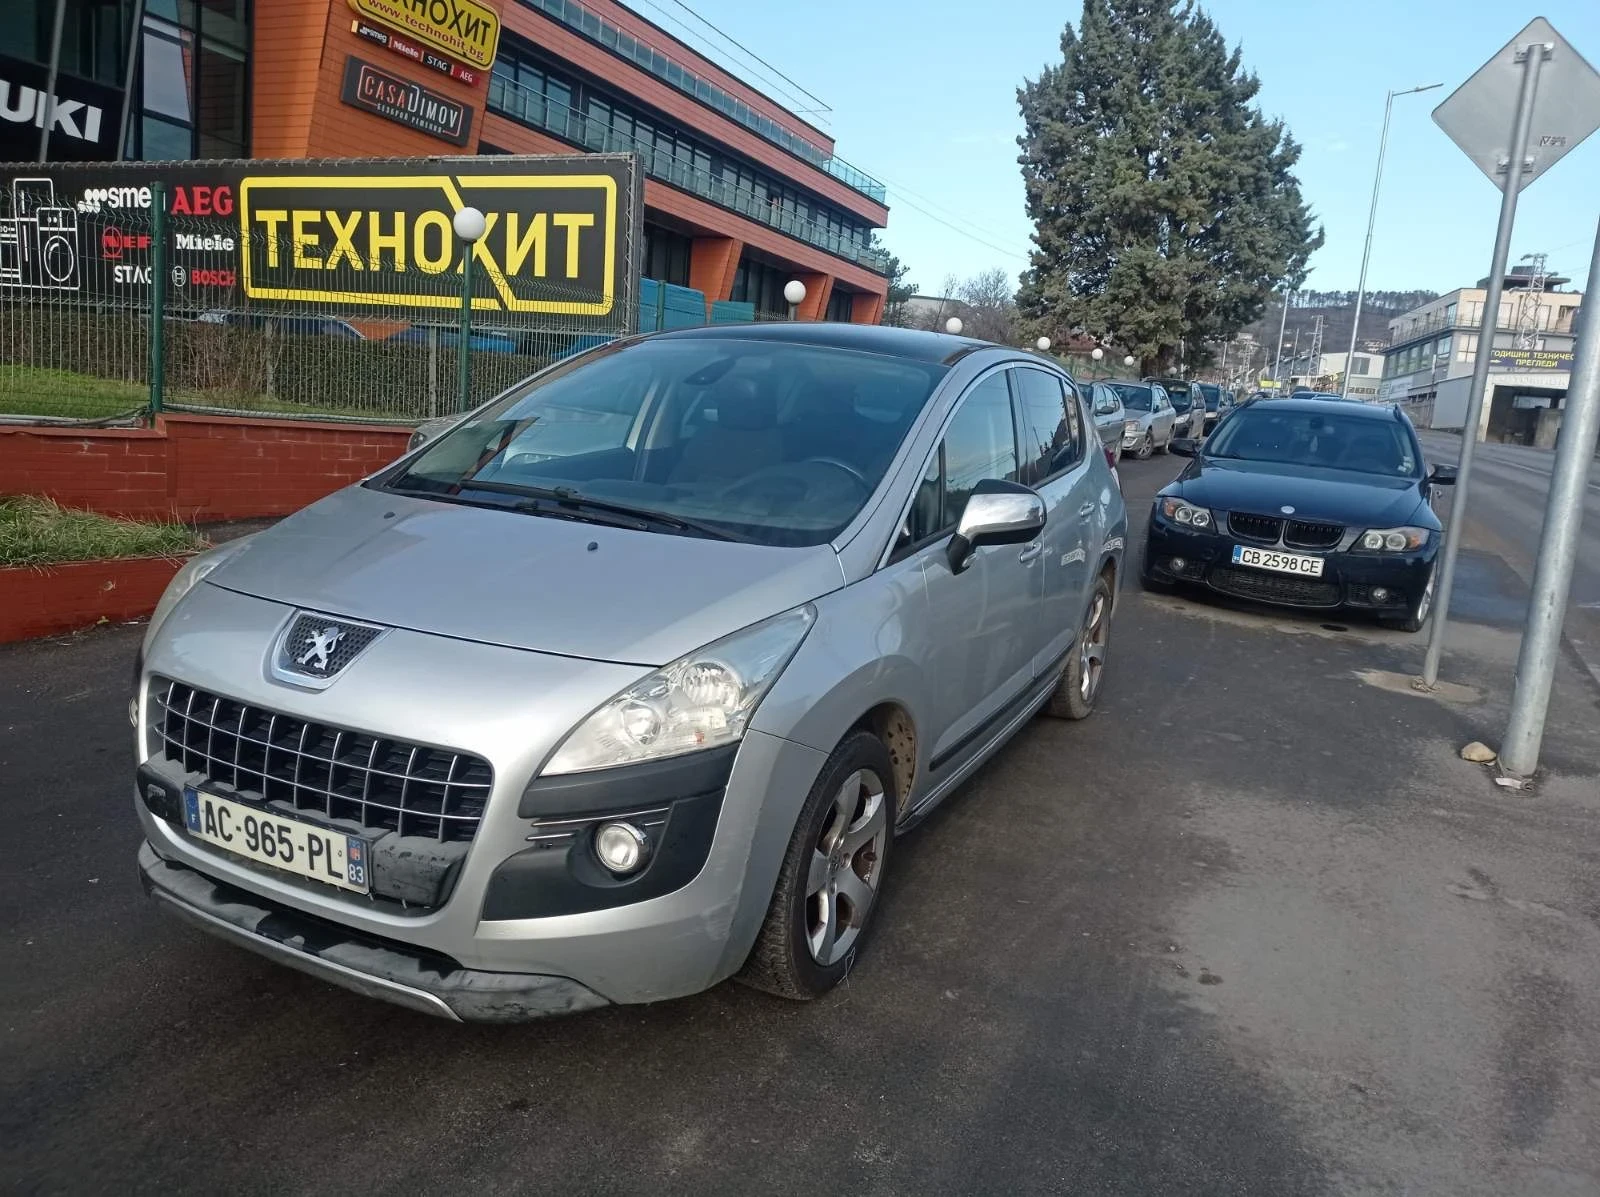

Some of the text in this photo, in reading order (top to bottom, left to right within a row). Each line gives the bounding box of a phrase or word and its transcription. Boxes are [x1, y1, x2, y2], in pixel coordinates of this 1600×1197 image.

[393, 40, 419, 58] Miele
[427, 55, 448, 71] STAG
[460, 71, 473, 83] AEG
[108, 187, 165, 212] sme
[171, 186, 233, 216] AEG
[176, 233, 234, 251] Miele
[255, 210, 594, 278] ТЕХНОХИТ
[192, 268, 236, 286] BOSCH
[1515, 359, 1558, 368] ПРЕГЛЕДИ
[1242, 550, 1320, 574] CB 2598 CE
[191, 814, 196, 823] F
[205, 801, 343, 880] AC-965-PL
[348, 863, 364, 884] 83
